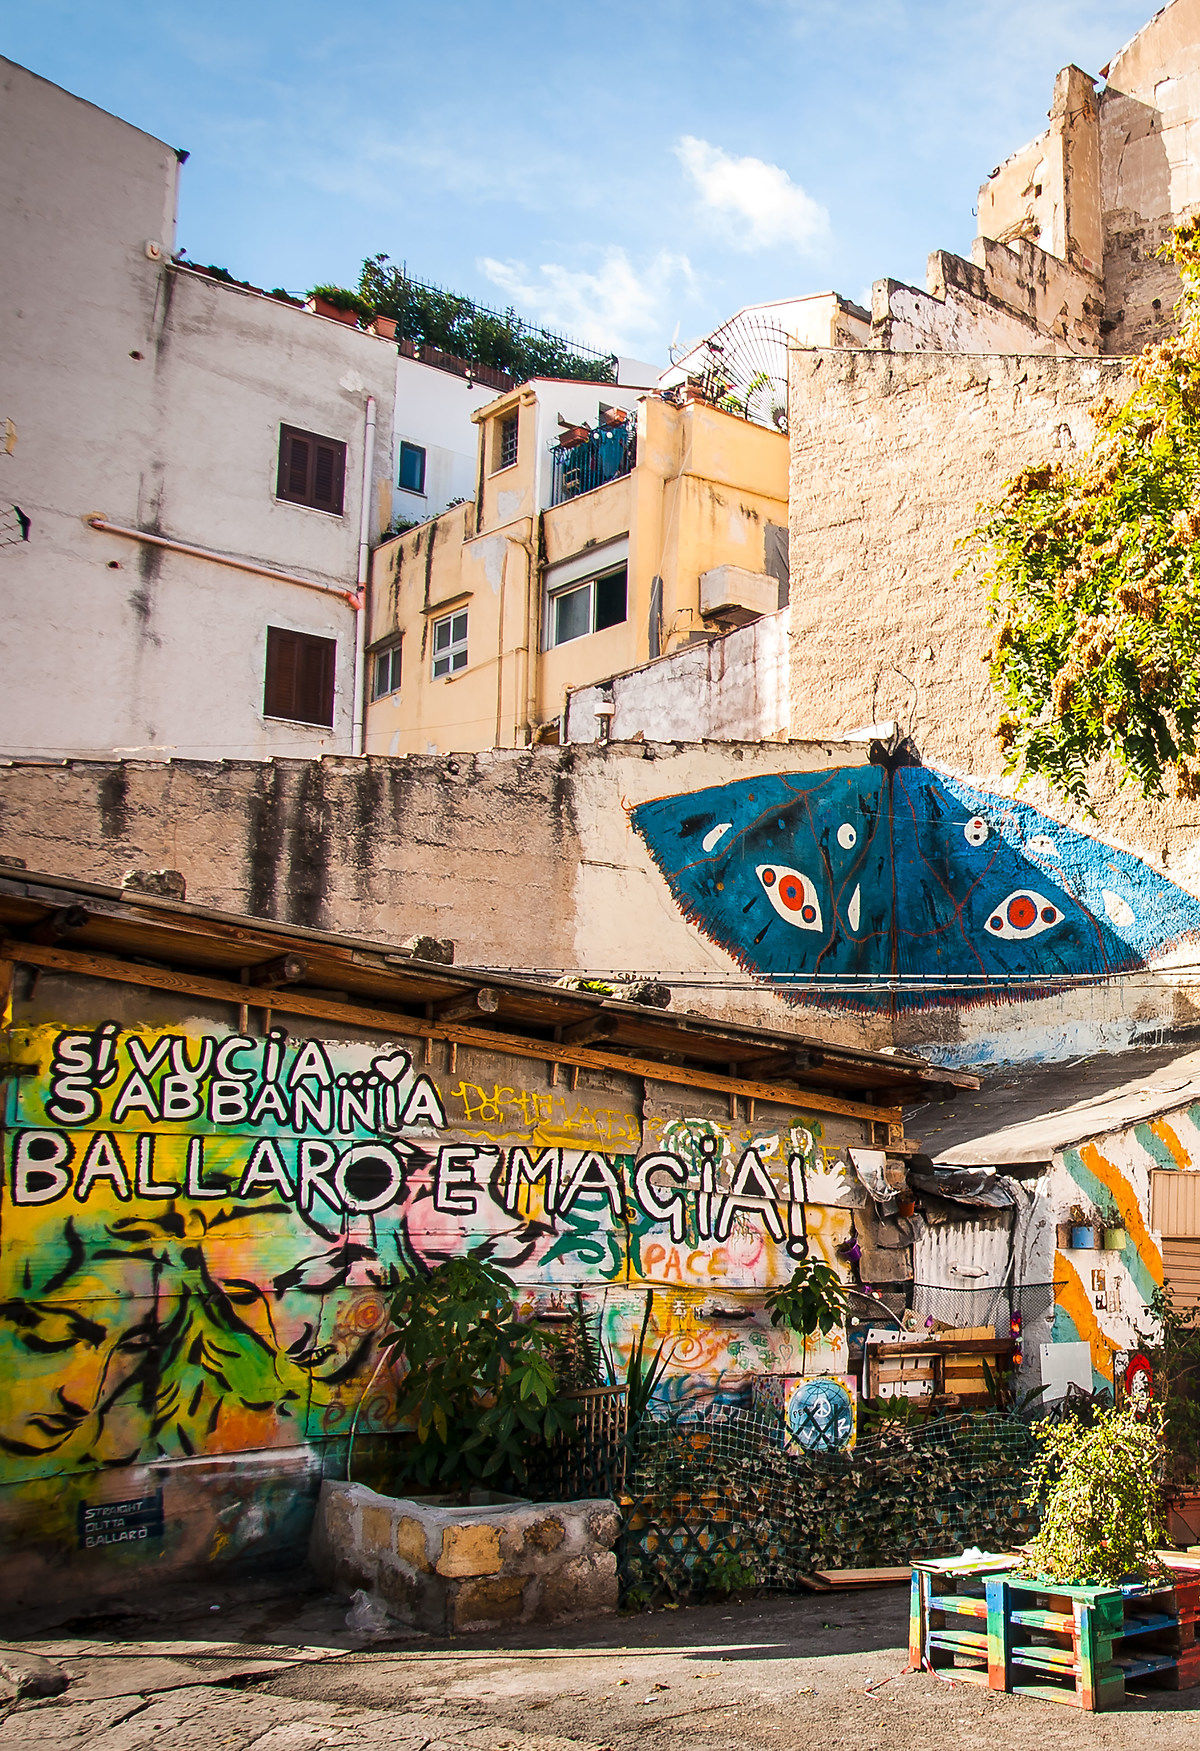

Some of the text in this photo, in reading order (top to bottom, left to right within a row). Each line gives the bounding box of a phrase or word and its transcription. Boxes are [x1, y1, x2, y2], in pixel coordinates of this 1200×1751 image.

[643, 1243, 728, 1280] PACE
[84, 1502, 143, 1519] STRAIGHT
[85, 1518, 125, 1533] OUTTA
